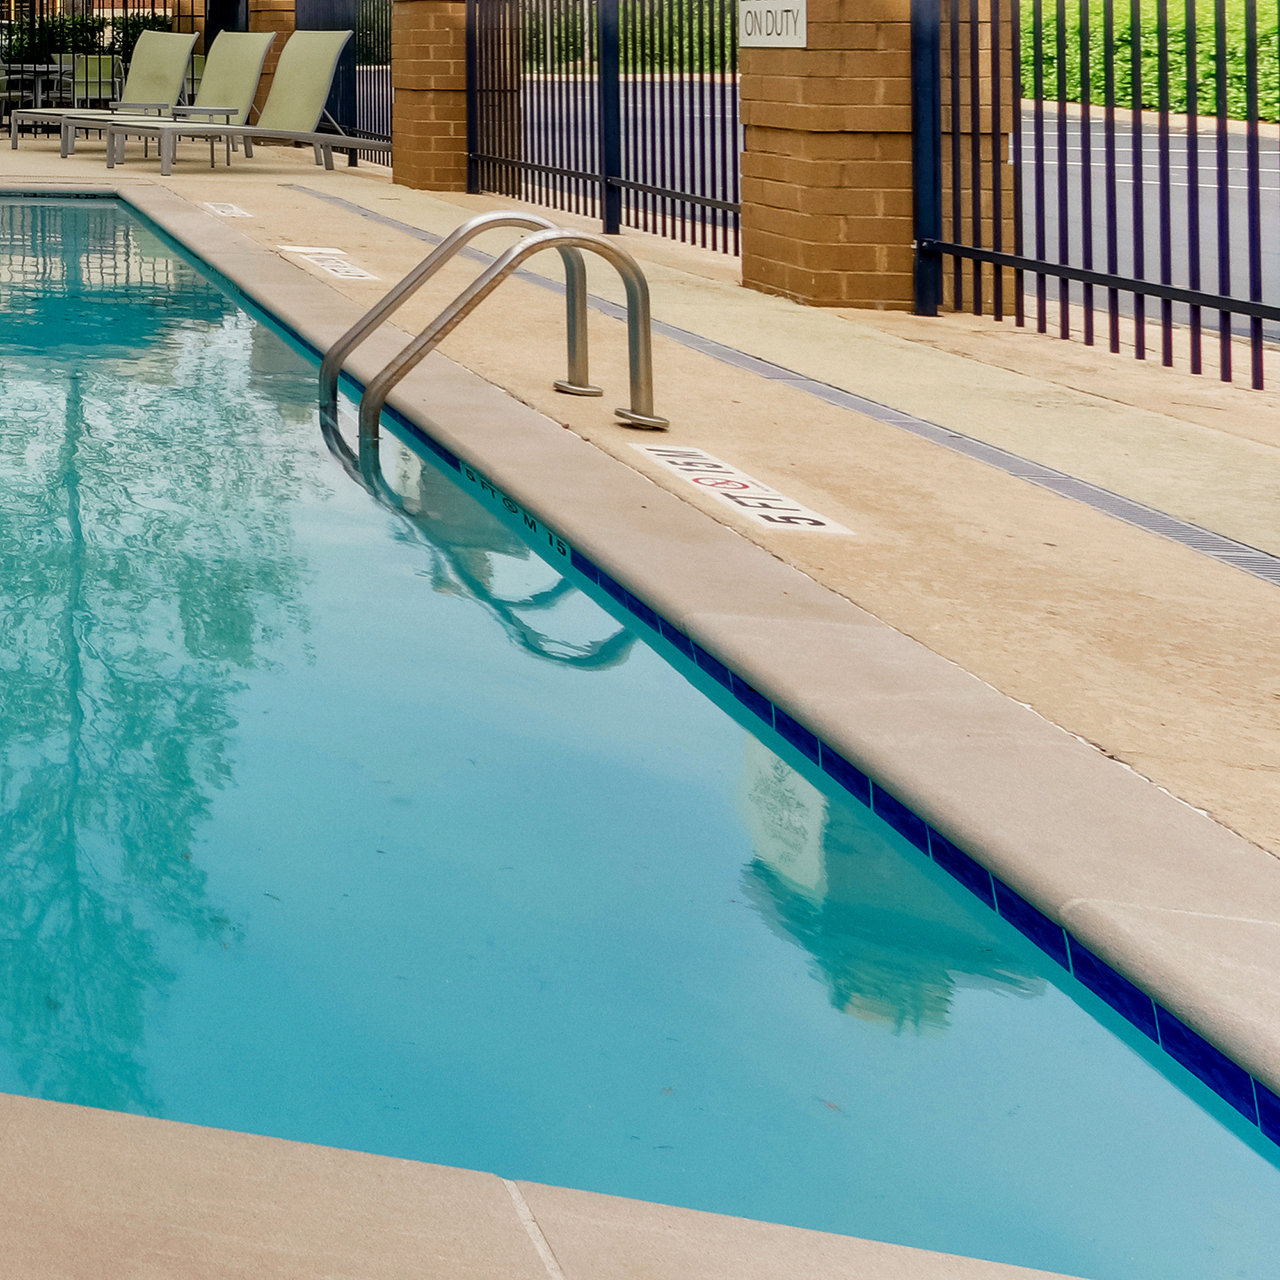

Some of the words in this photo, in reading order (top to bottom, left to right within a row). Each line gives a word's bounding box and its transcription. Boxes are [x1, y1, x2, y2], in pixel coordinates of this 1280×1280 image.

[744, 11, 762, 37] ON
[766, 9, 799, 37] DUTY
[465, 467, 476, 482] 5
[480, 480, 496, 499] FT
[524, 513, 537, 533] M
[720, 492, 800, 511] FT
[757, 514, 826, 526] 5
